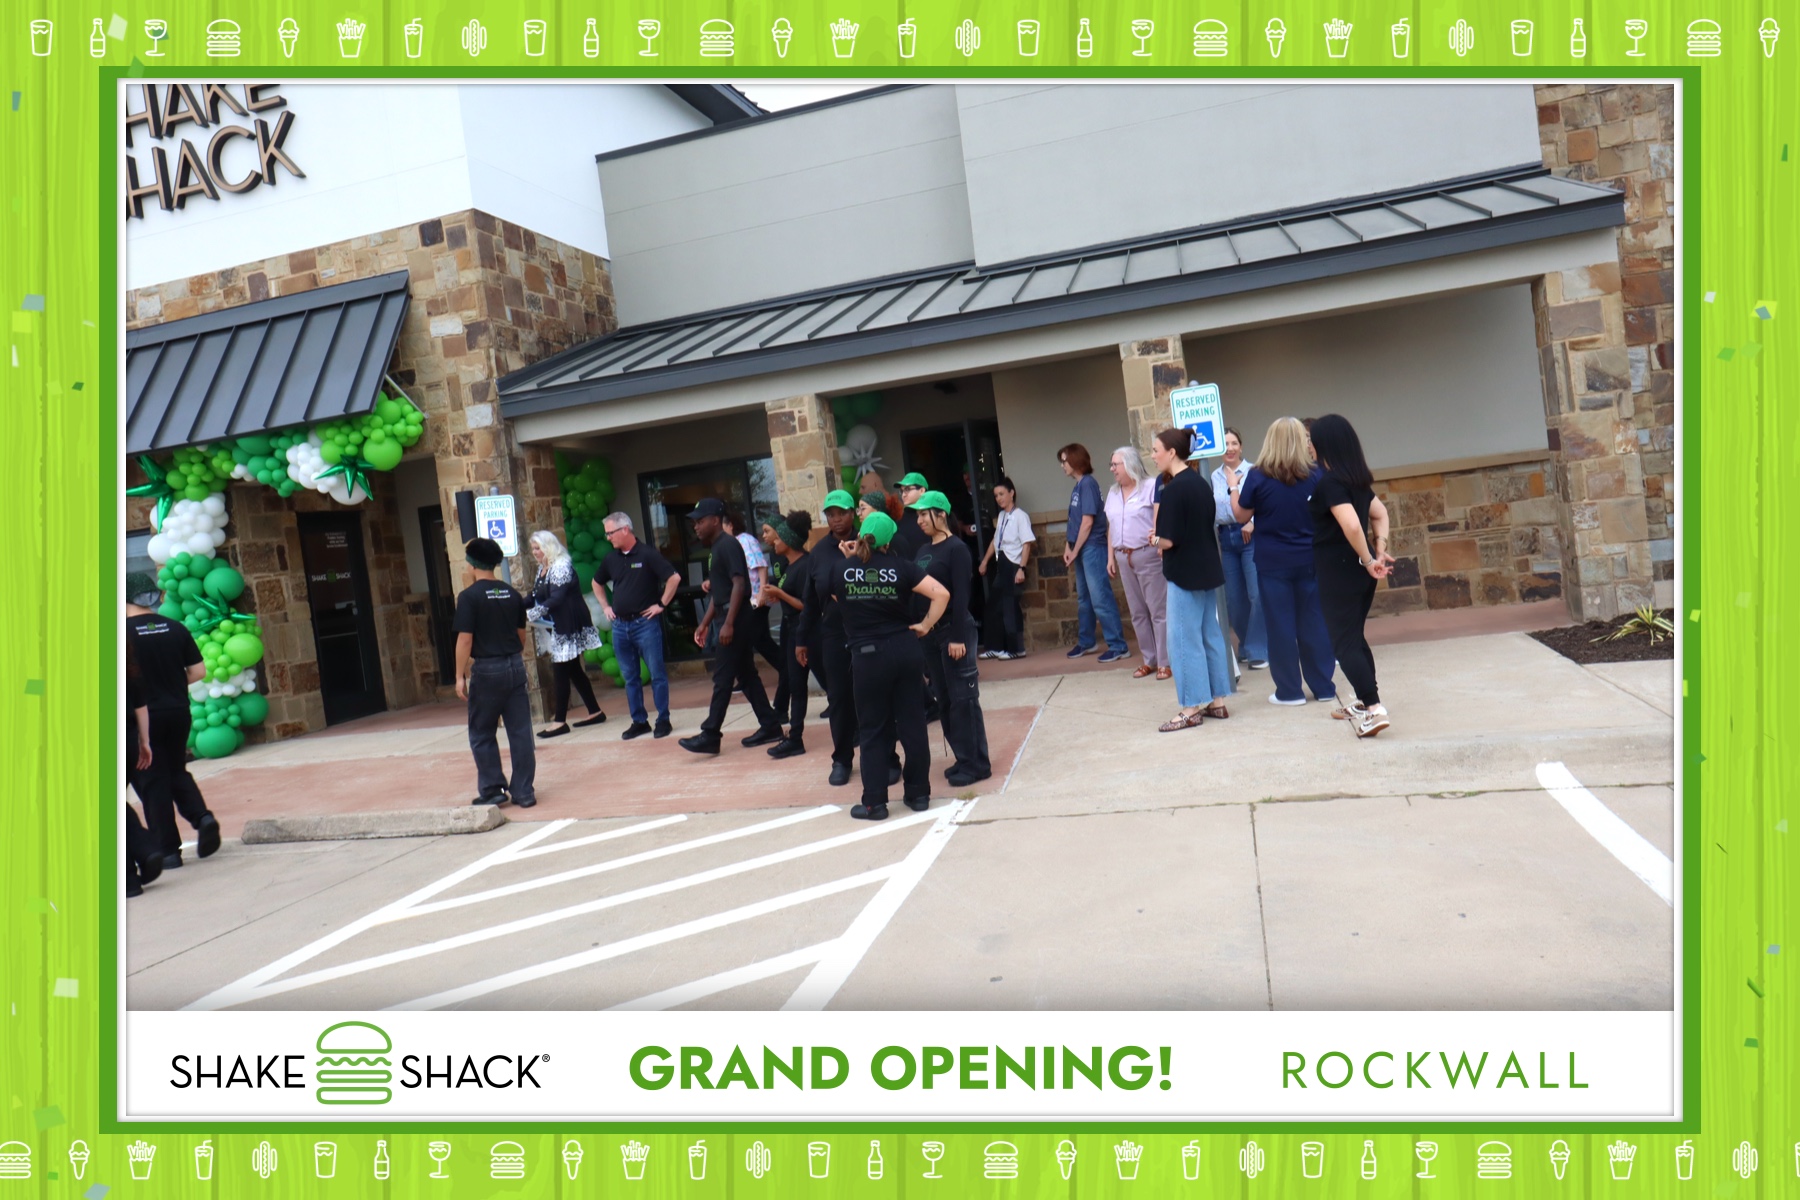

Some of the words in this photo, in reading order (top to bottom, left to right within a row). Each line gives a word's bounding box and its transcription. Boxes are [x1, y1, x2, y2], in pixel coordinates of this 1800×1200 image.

[126, 110, 306, 221] HACK
[1175, 393, 1216, 409] RESERVED
[1179, 406, 1215, 420] PARKING
[479, 499, 511, 510] RESERVED
[483, 510, 508, 519] PARKING
[845, 583, 897, 595] Trainer
